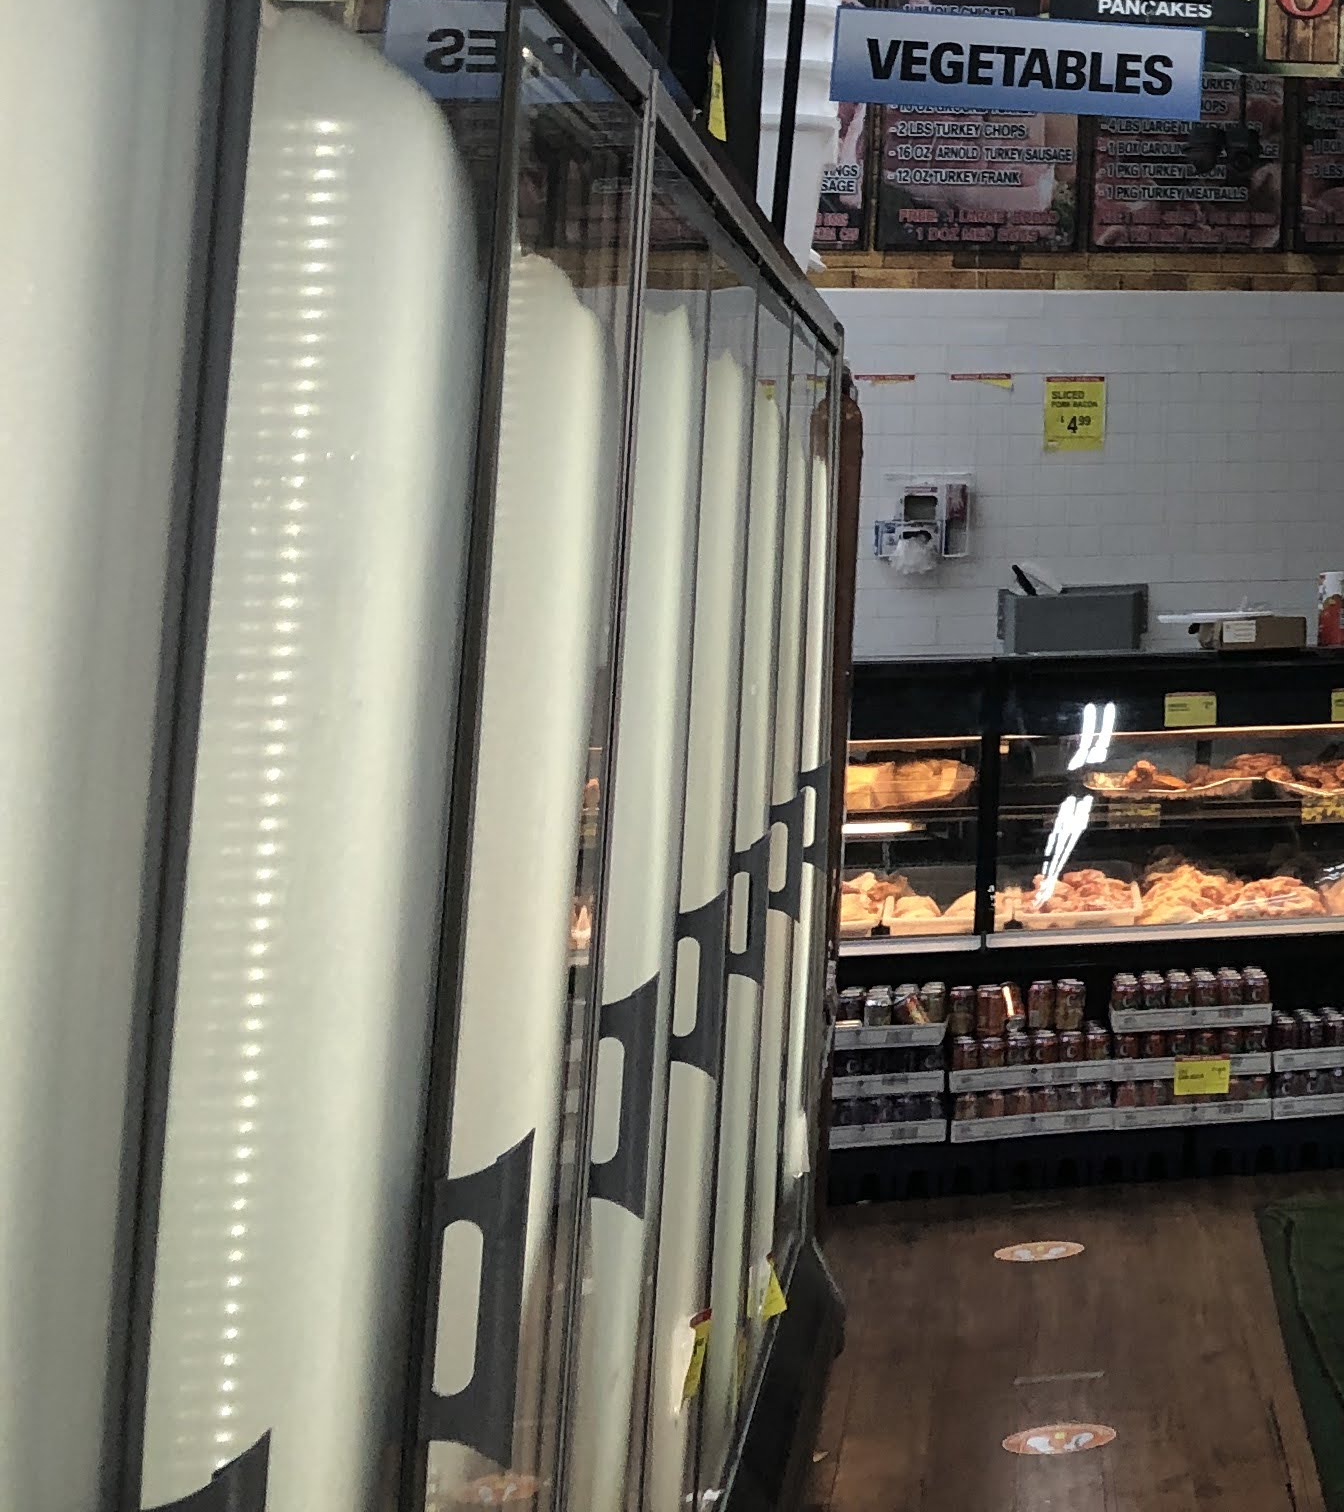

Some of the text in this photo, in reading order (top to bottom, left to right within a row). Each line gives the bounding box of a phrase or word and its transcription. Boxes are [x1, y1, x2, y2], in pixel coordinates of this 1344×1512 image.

[867, 38, 1174, 97] VEGETABLES
[1202, 79, 1236, 91] URKEY
[910, 124, 1026, 137] LBS TURKEY CHOPS
[1143, 121, 1178, 134] LARGE
[914, 147, 931, 159] OZ
[937, 147, 979, 160] ARNOLD
[985, 148, 1023, 161] TURKEY
[1025, 149, 1072, 161] SAUSAGE
[932, 171, 979, 184] TURKEY
[982, 171, 1020, 184] FRANK
[1142, 165, 1184, 178] TURKEY
[1142, 187, 1184, 201] TURKEY
[1185, 187, 1248, 201] MEATBALLS
[1051, 390, 1085, 400] SLICED
